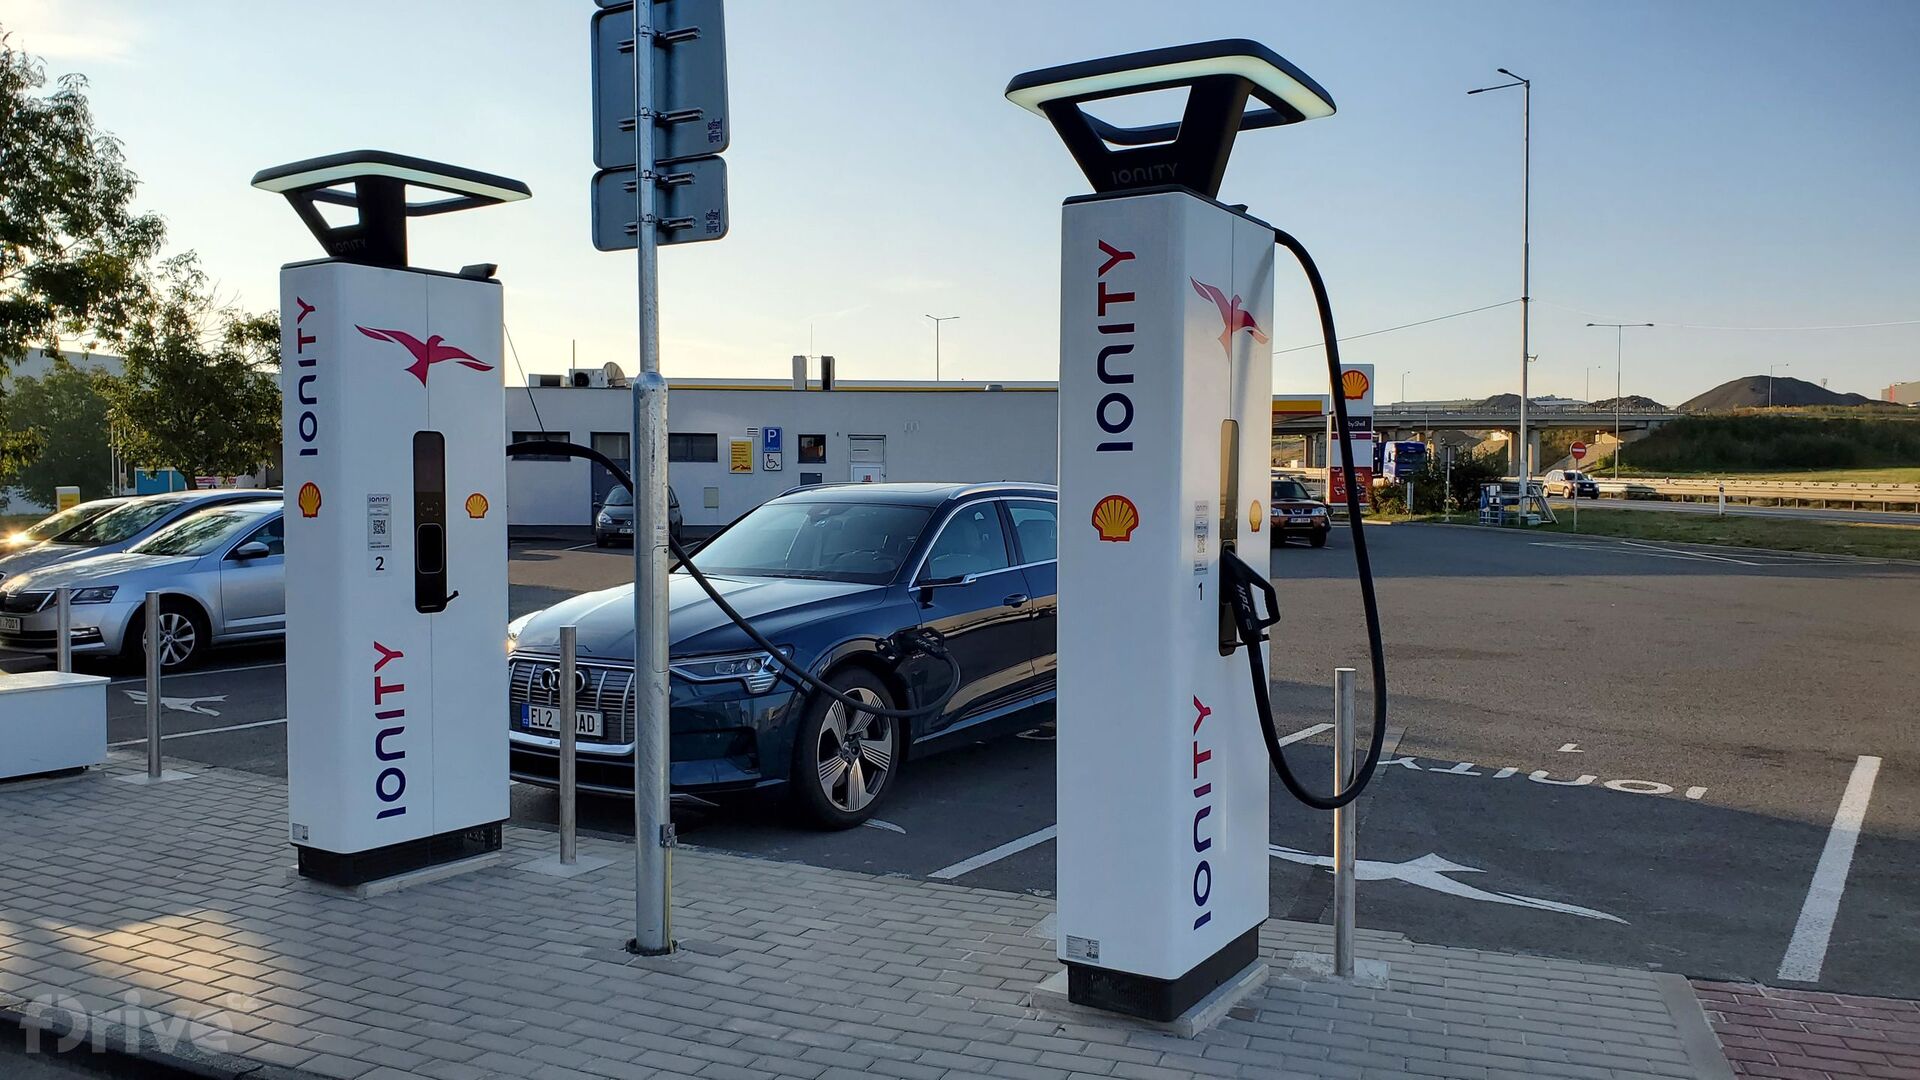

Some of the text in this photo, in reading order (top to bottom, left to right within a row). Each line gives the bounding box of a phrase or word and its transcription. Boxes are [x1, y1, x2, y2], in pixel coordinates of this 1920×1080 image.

[1112, 162, 1178, 185] IONITY
[1096, 239, 1136, 452] IONITY
[296, 296, 318, 457] IONITY
[767, 429, 777, 443] P
[375, 556, 385, 571] 2
[1198, 582, 1203, 601] 1
[374, 640, 406, 820] IONITY
[1377, 756, 1708, 800] IONITY
[1193, 694, 1212, 931] IONITY
